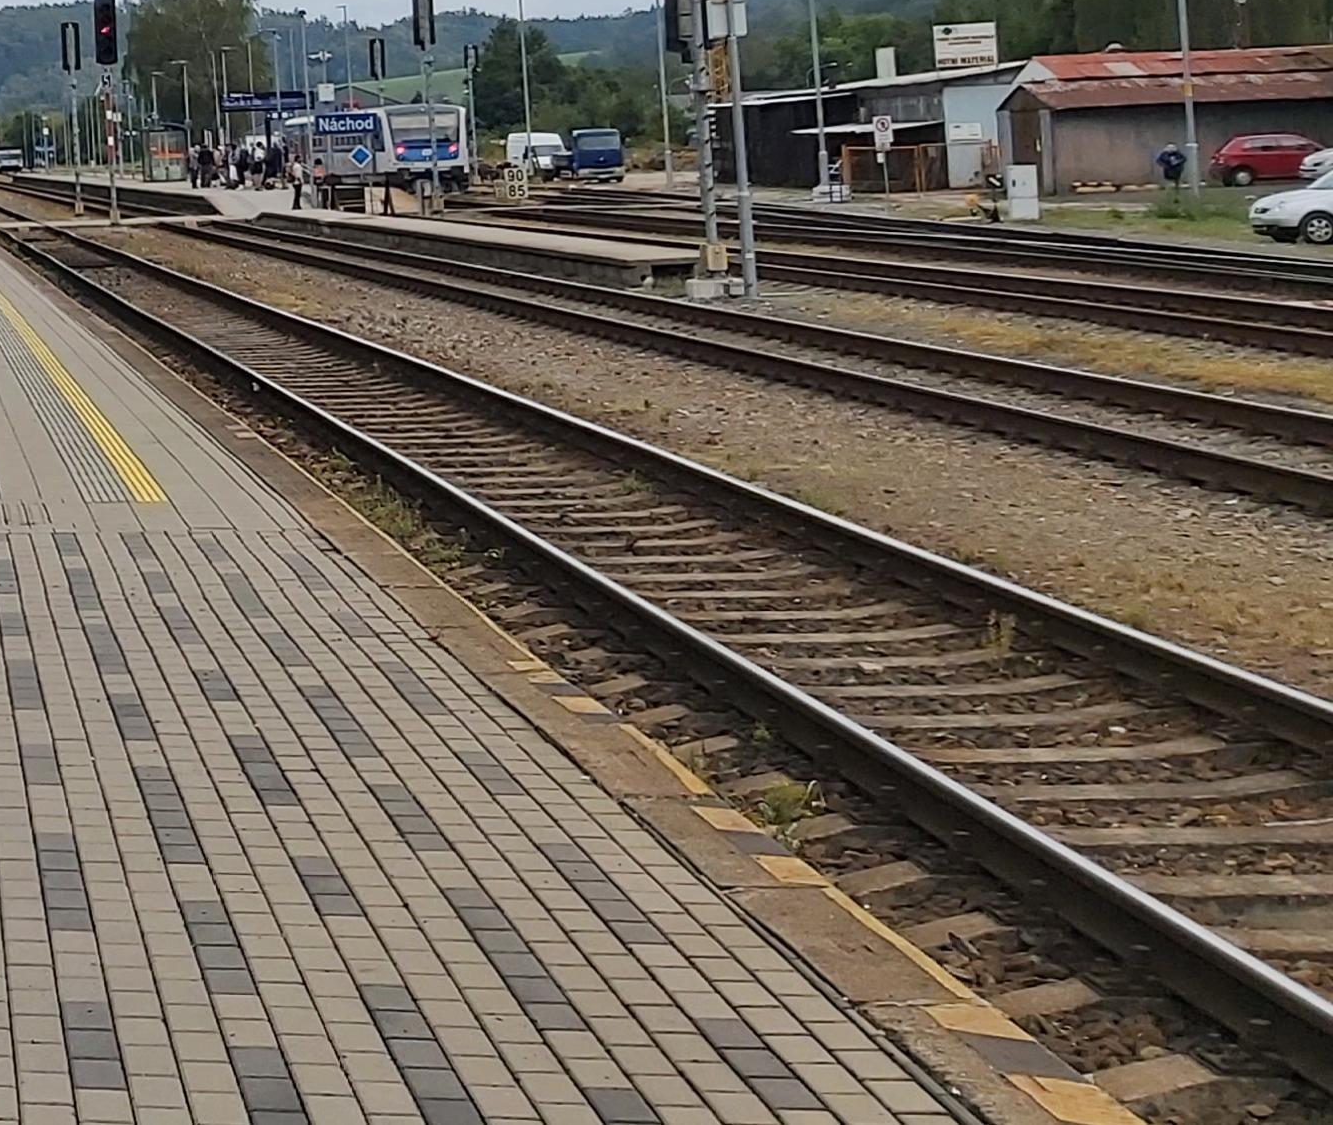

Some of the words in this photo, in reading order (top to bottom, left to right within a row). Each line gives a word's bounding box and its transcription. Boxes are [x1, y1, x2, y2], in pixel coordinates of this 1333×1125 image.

[318, 115, 374, 132] Náchod
[507, 169, 524, 182] 90
[508, 184, 526, 197] 85
